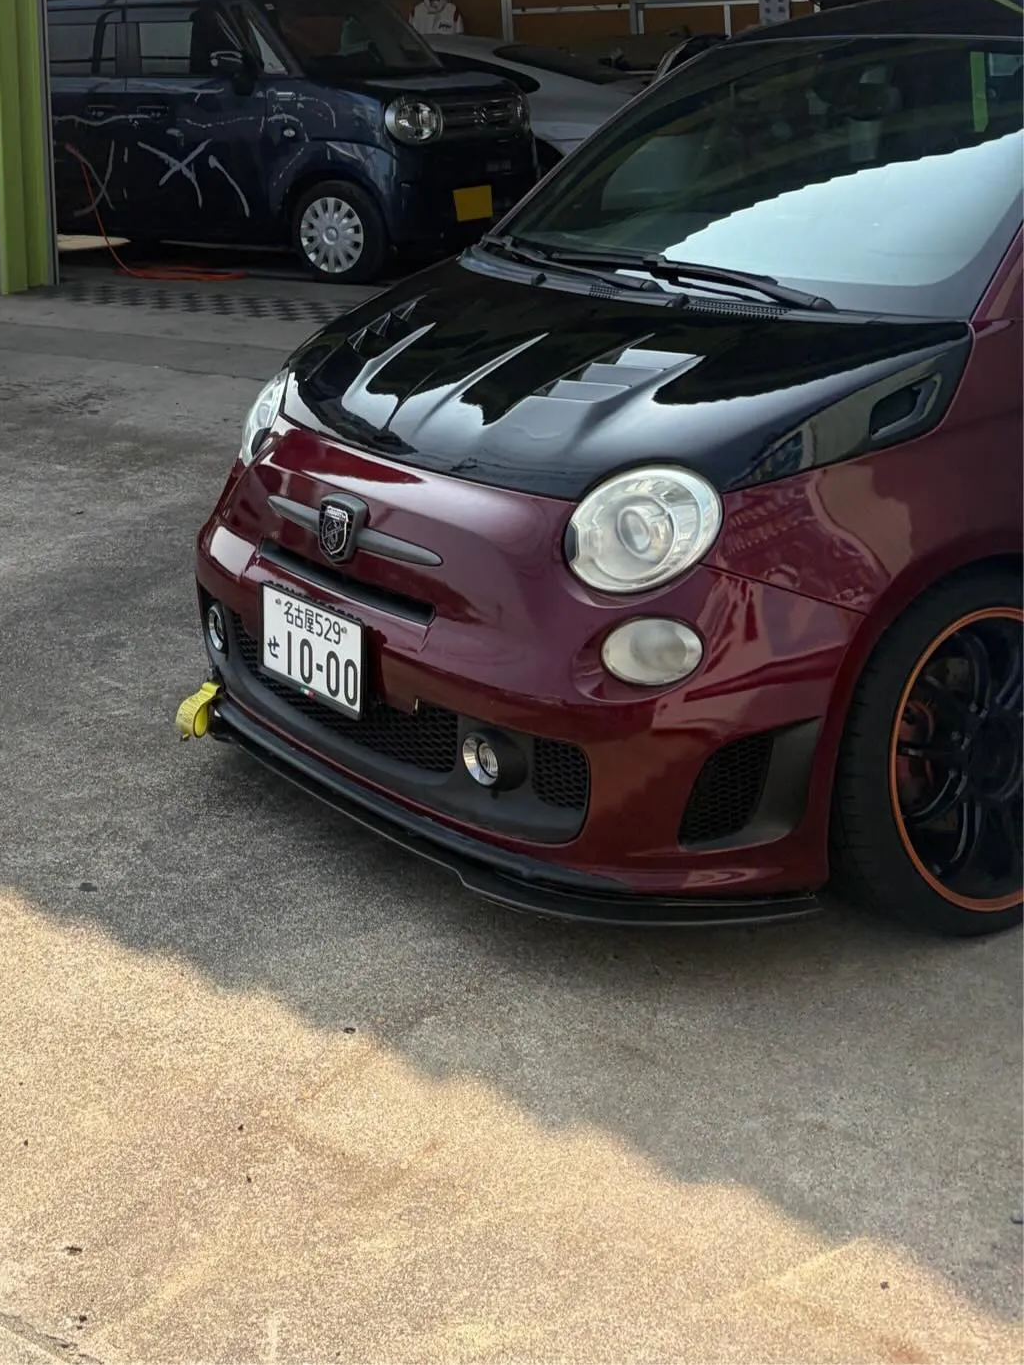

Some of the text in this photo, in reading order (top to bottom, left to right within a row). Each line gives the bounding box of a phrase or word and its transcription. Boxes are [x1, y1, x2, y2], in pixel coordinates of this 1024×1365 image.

[283, 601, 341, 645] 名古屋529
[267, 630, 358, 707] せ 10-00
